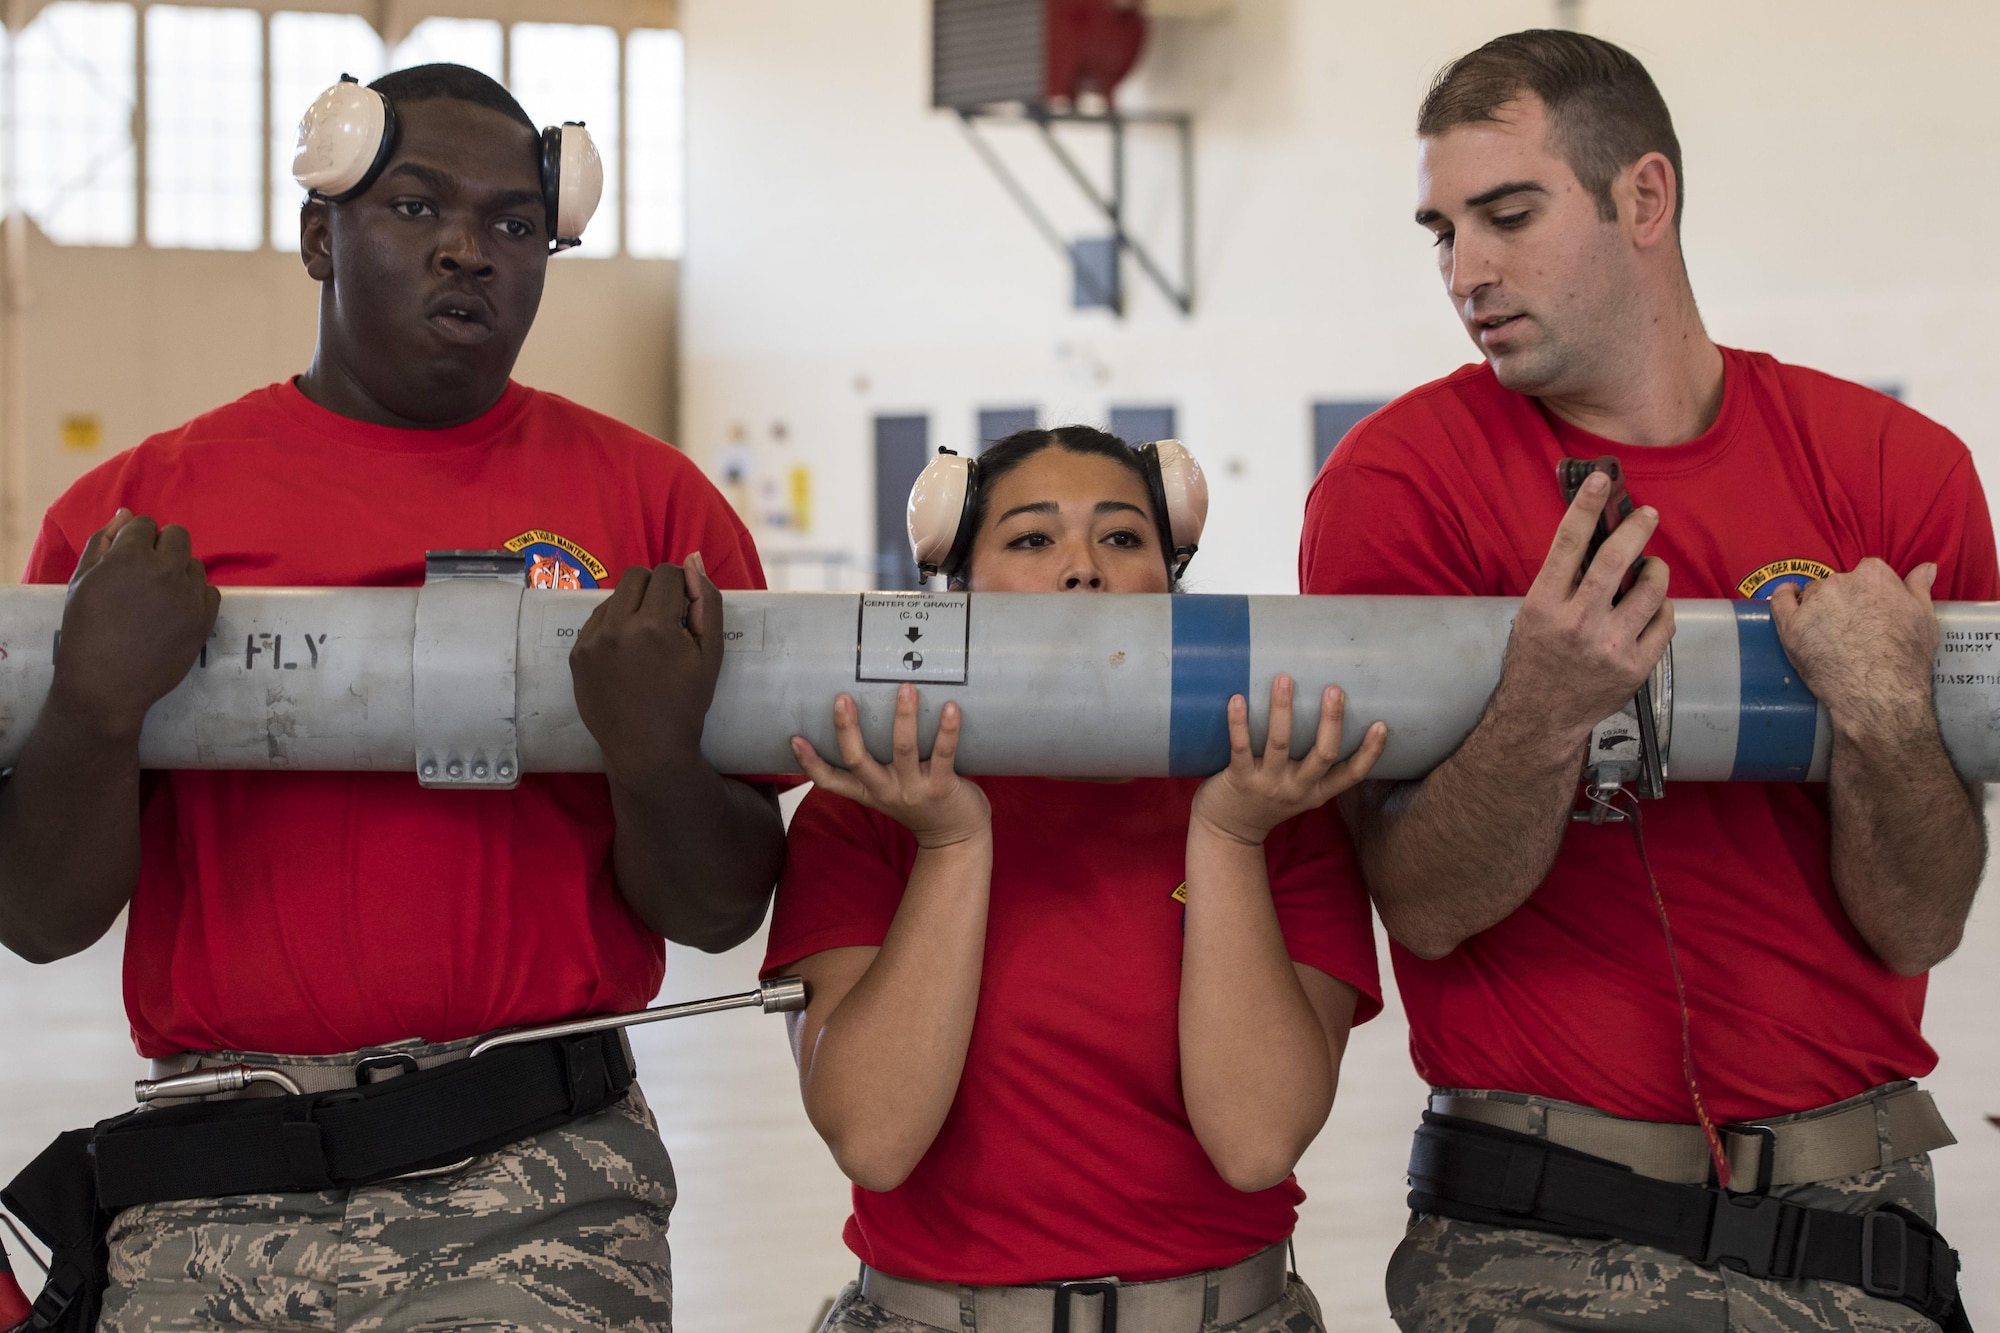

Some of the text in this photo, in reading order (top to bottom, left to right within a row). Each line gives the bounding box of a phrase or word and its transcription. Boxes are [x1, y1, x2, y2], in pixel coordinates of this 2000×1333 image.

[509, 531, 603, 575] FLYING TIGER MAINTENANCE
[1764, 562, 1788, 577] TIGER
[1791, 560, 1831, 579] MAINTENA
[907, 600, 921, 608] OF
[923, 601, 965, 609] GRAVITY
[557, 628, 574, 637] DO
[246, 633, 327, 669] FLY
[1945, 643, 1992, 652] DUMMY
